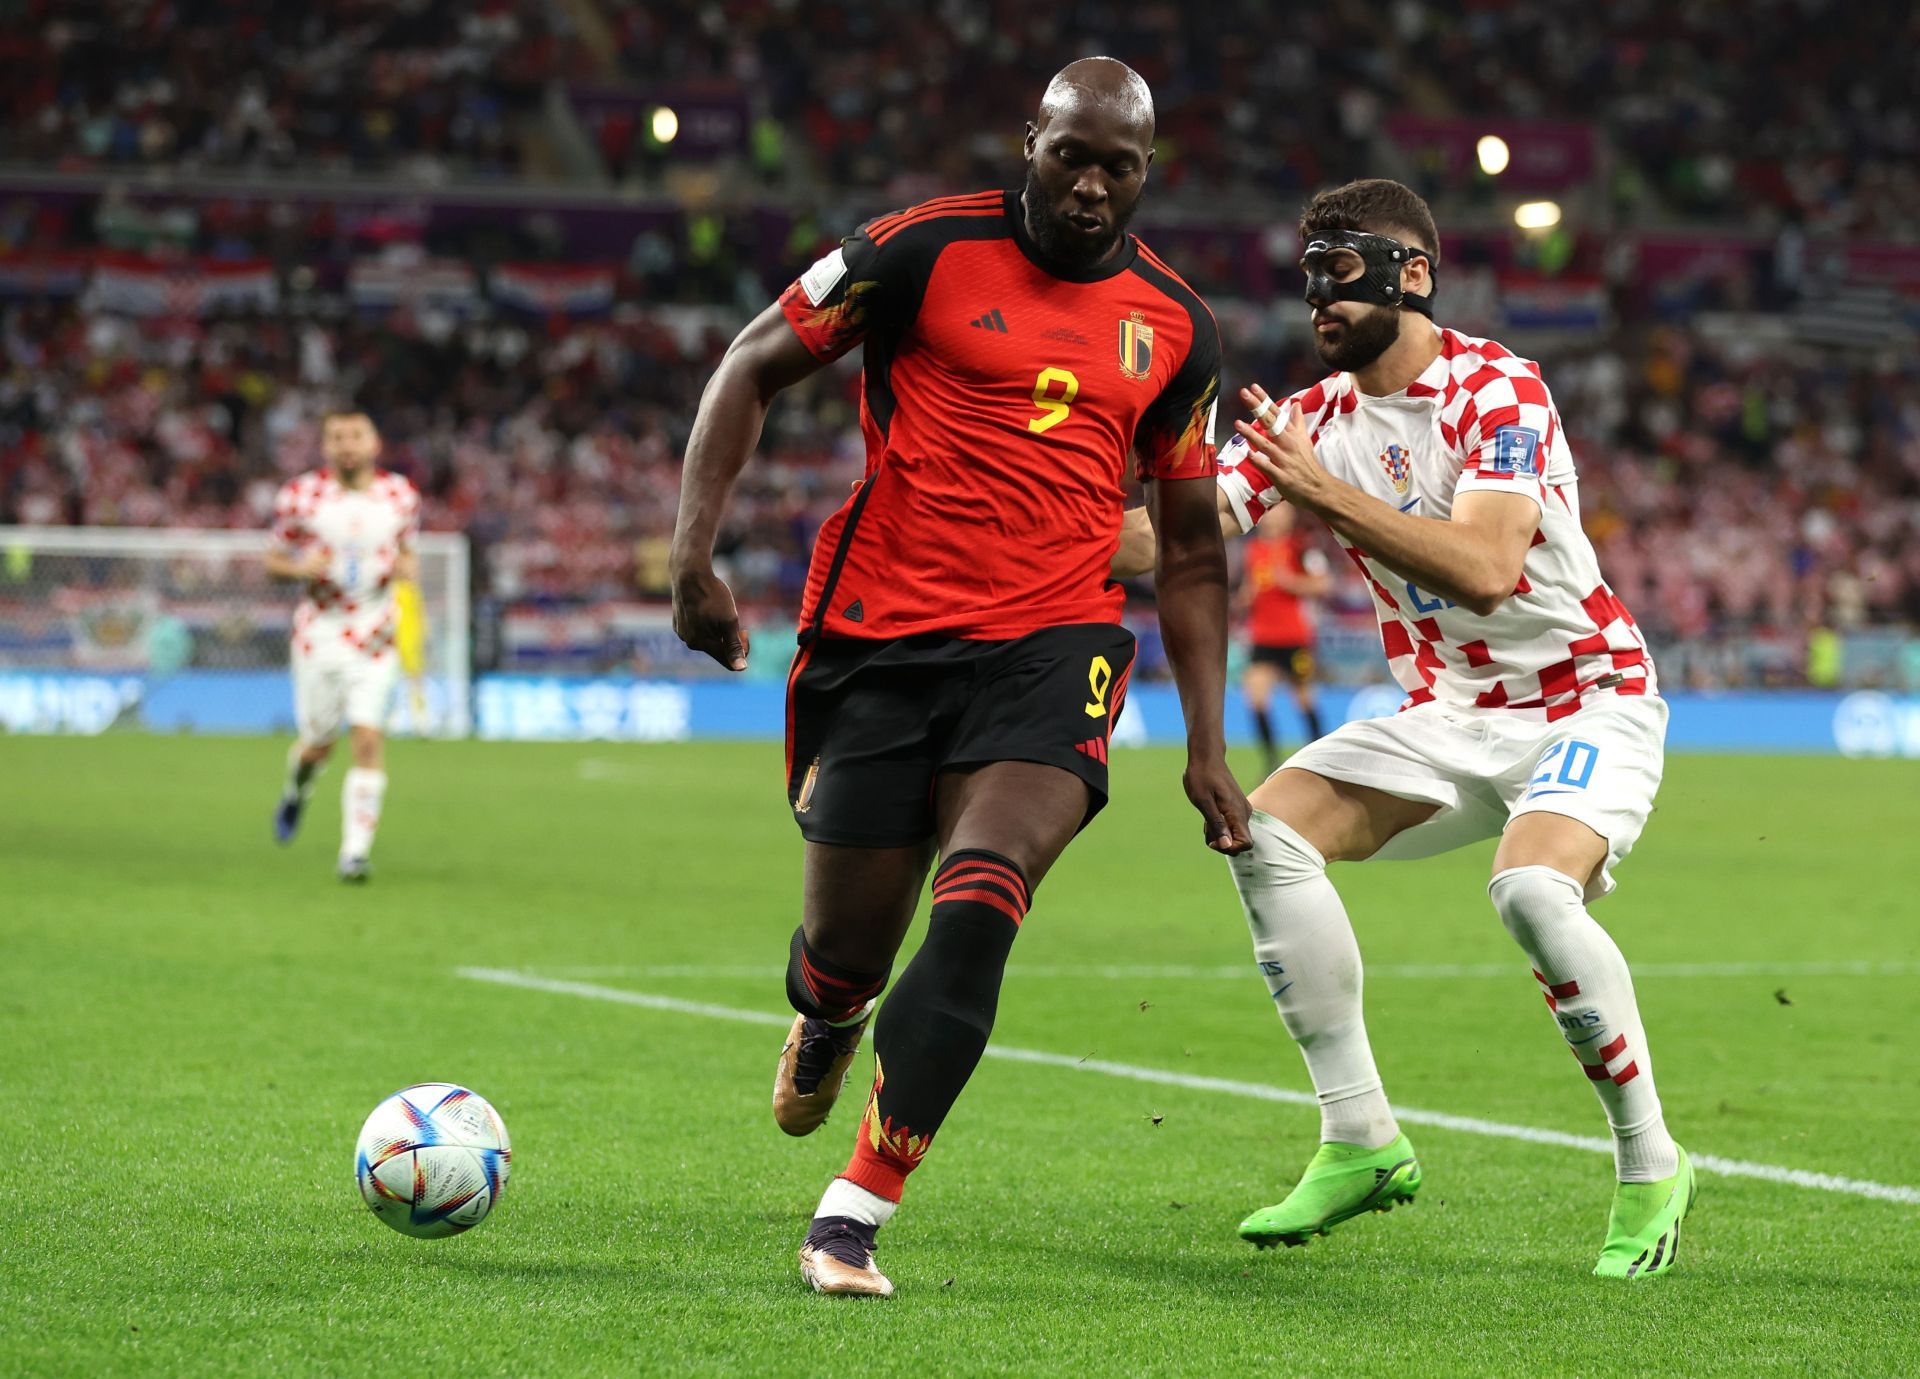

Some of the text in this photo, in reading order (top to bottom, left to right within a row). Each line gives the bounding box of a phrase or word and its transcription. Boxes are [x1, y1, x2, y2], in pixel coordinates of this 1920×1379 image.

[1028, 367, 1079, 433] 9
[1085, 655, 1111, 718] 9
[1528, 740, 1599, 789] 20
